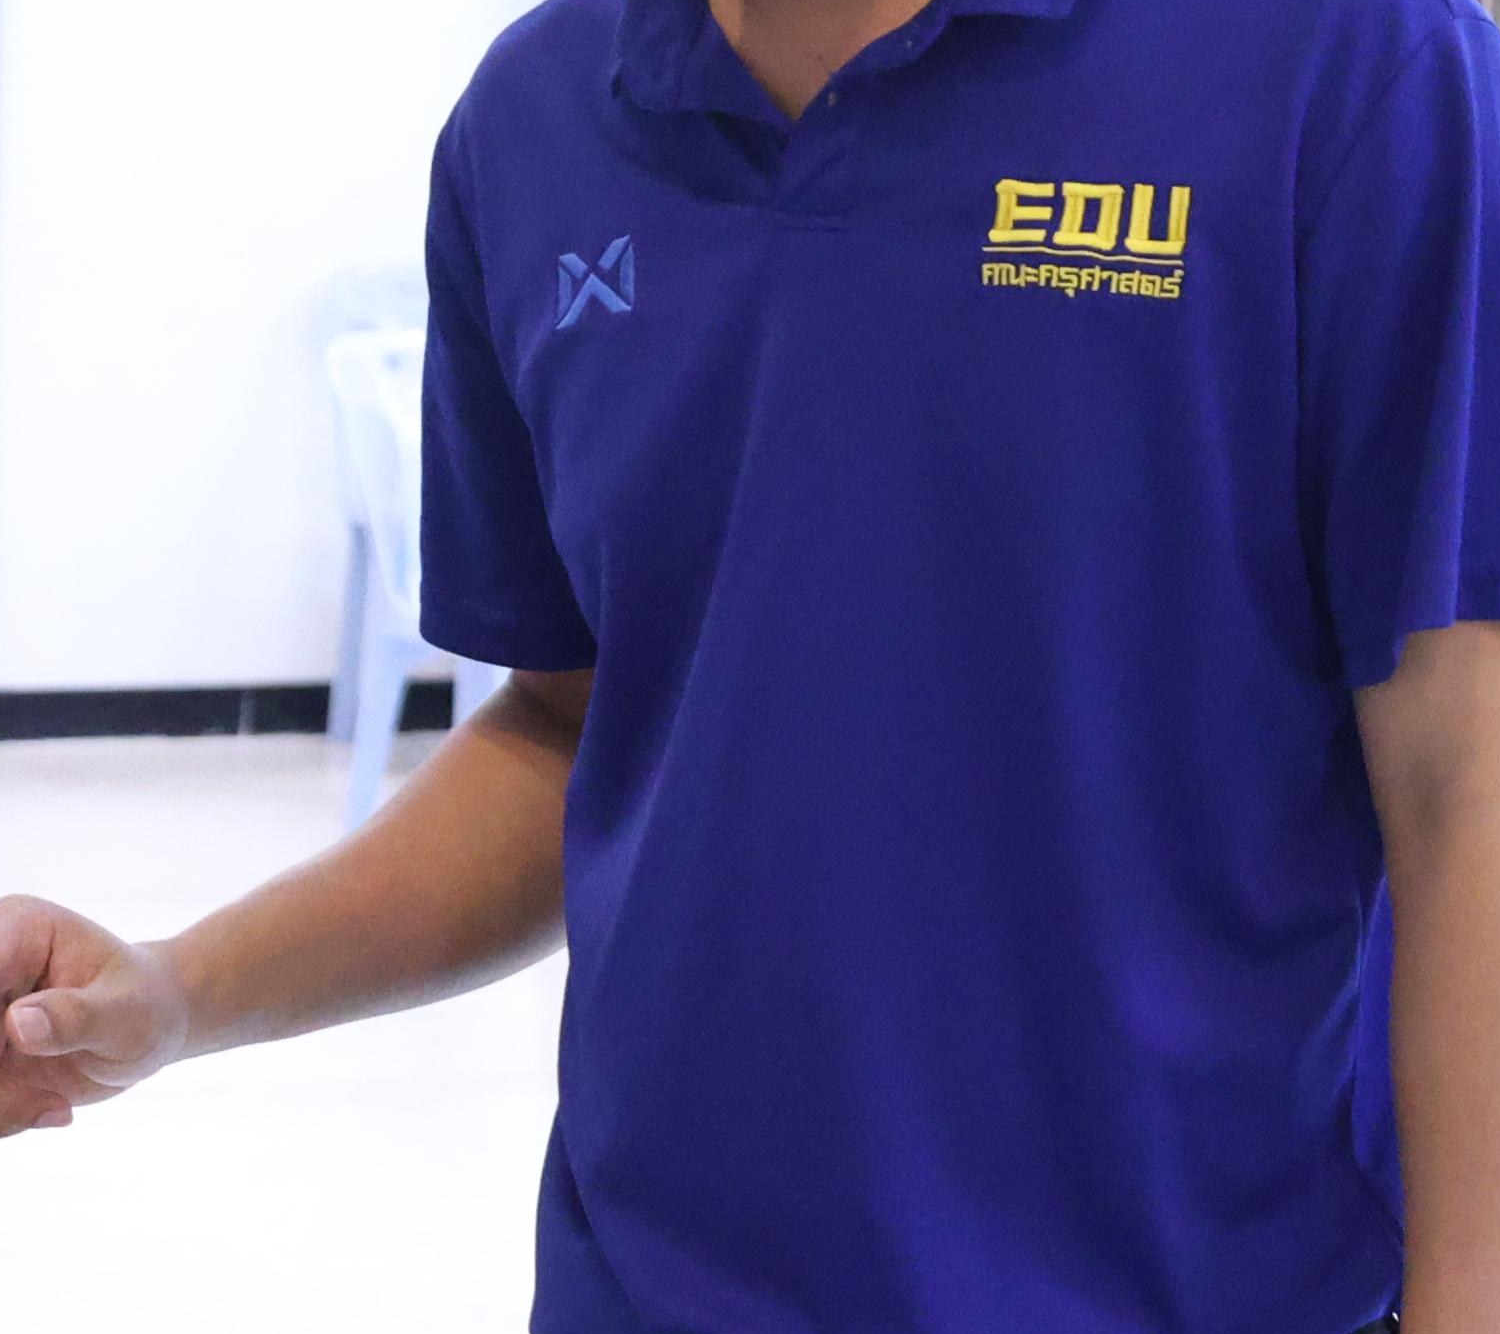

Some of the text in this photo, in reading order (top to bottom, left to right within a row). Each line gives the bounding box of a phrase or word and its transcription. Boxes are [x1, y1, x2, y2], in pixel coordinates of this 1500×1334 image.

[988, 179, 1191, 254] EDU
[981, 262, 1184, 299] คณะครุศาสตร์
